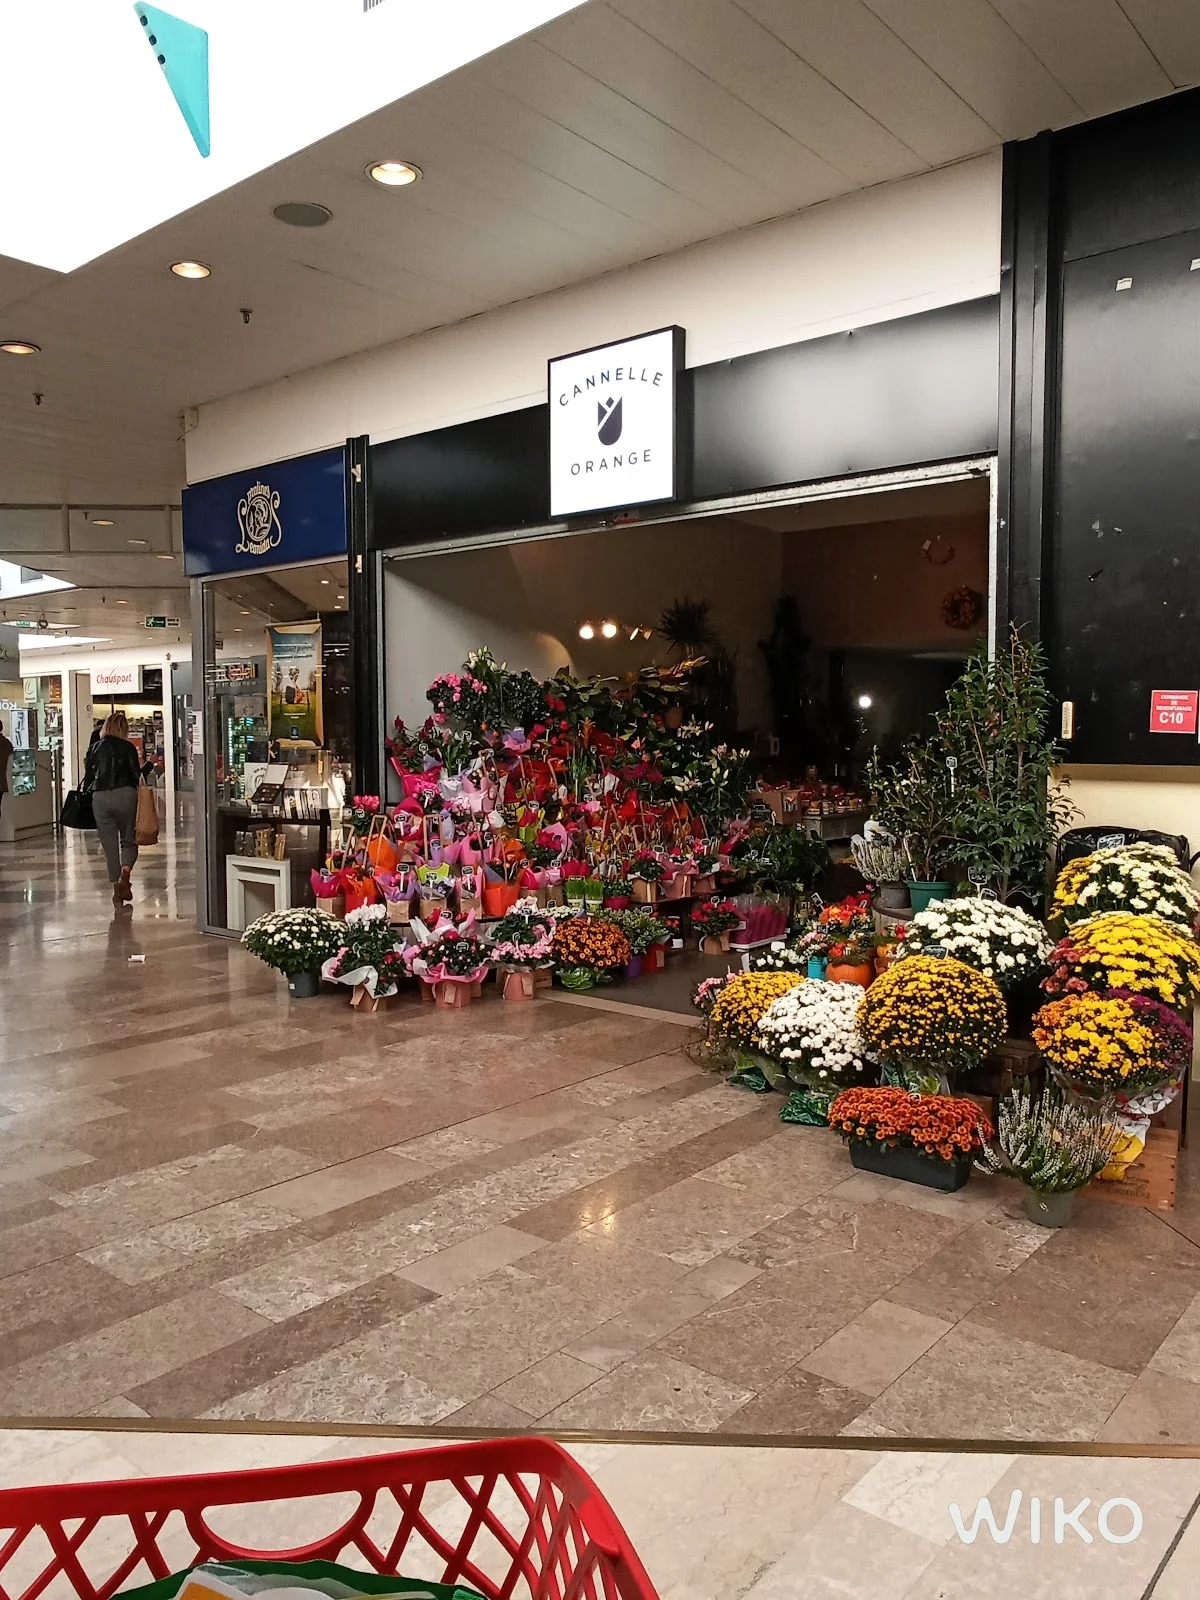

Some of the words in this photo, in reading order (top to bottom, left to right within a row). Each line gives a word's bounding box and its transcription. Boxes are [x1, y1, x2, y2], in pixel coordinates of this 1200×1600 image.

[559, 367, 664, 407] CANNELLE
[570, 449, 652, 476] ORANGE
[96, 672, 132, 685] Chausport
[1159, 711, 1184, 724] C10
